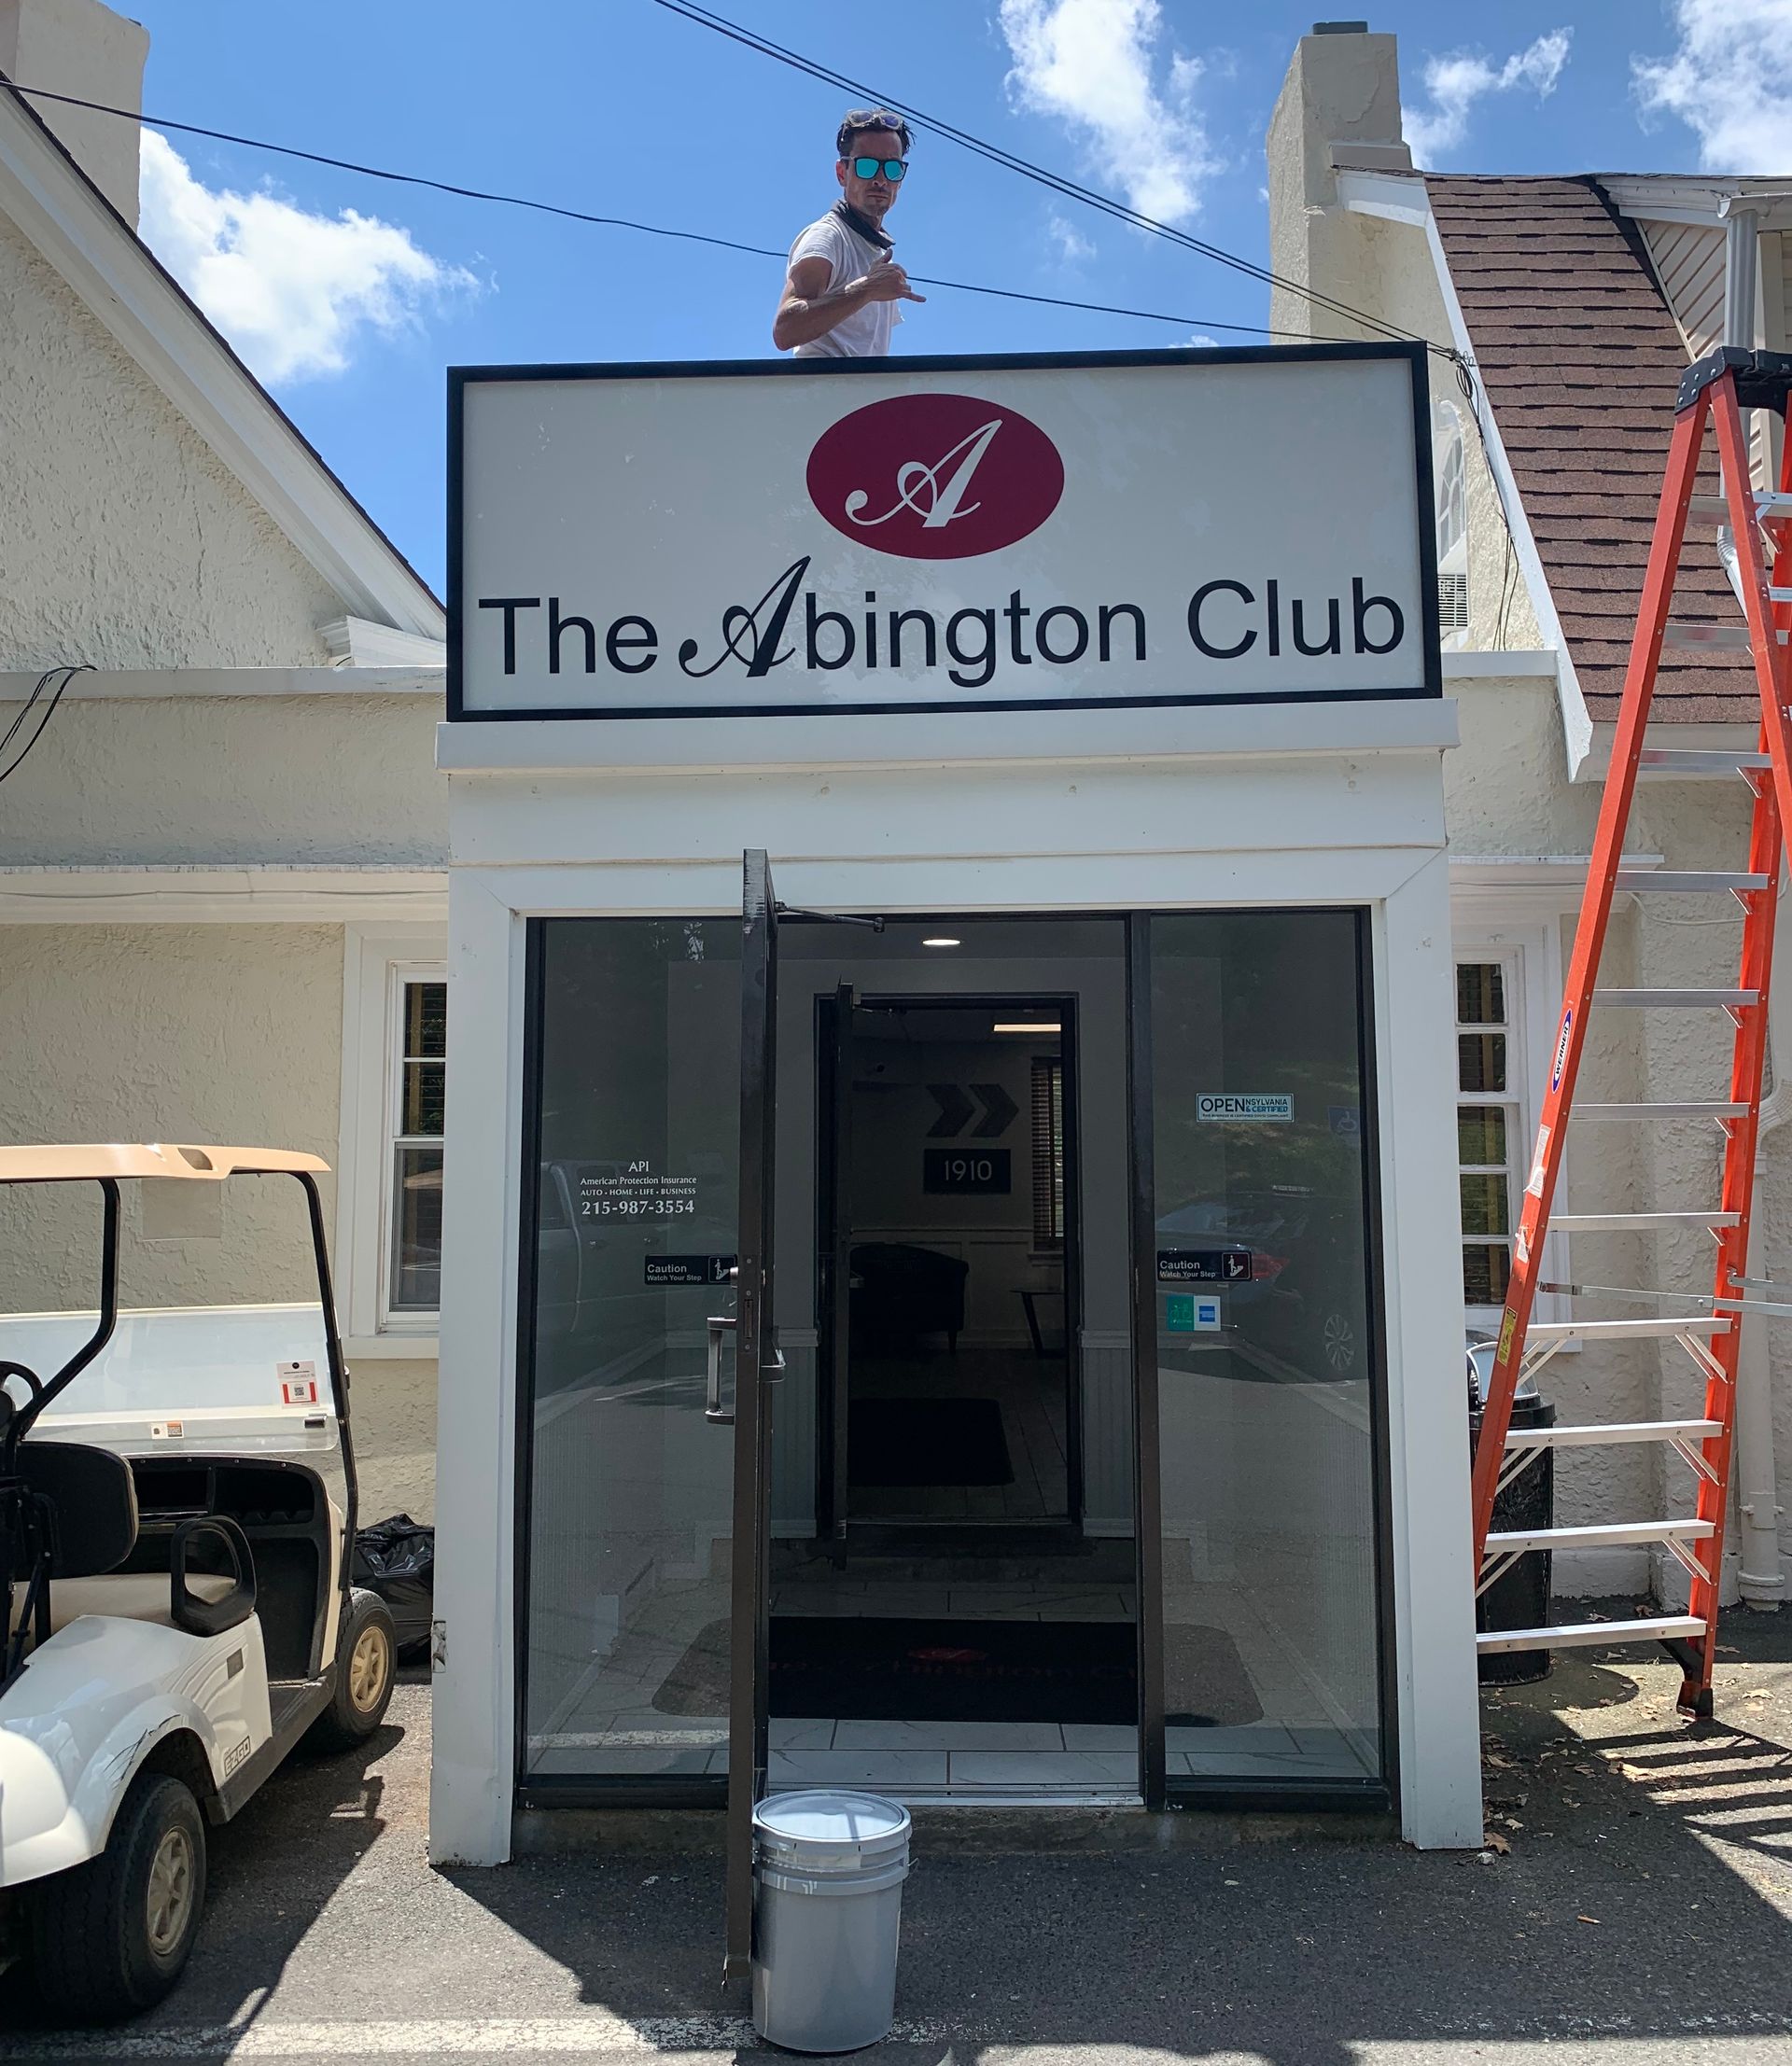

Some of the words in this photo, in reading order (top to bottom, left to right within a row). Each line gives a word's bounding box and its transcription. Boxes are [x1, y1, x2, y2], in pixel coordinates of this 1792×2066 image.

[845, 418, 1002, 528] A
[479, 597, 659, 676] The
[679, 555, 1147, 689] Abington
[1187, 576, 1406, 659] Club
[1555, 1026, 1570, 1075] WERNER
[1200, 1097, 1245, 1112] OPEN
[628, 1161, 650, 1172] API
[944, 1159, 993, 1181] 1910
[580, 1176, 618, 1185] American
[619, 1176, 659, 1185] Protection
[661, 1176, 697, 1184] Insurance
[661, 1187, 696, 1195] BUSINESS
[581, 1200, 695, 1215] 215-987-3554
[647, 1263, 687, 1274] Caution
[1159, 1260, 1201, 1270] Caution
[686, 1274, 702, 1282] Step
[1159, 1270, 1182, 1278] Watch
[1183, 1270, 1198, 1278] Your
[1199, 1270, 1216, 1279] Step
